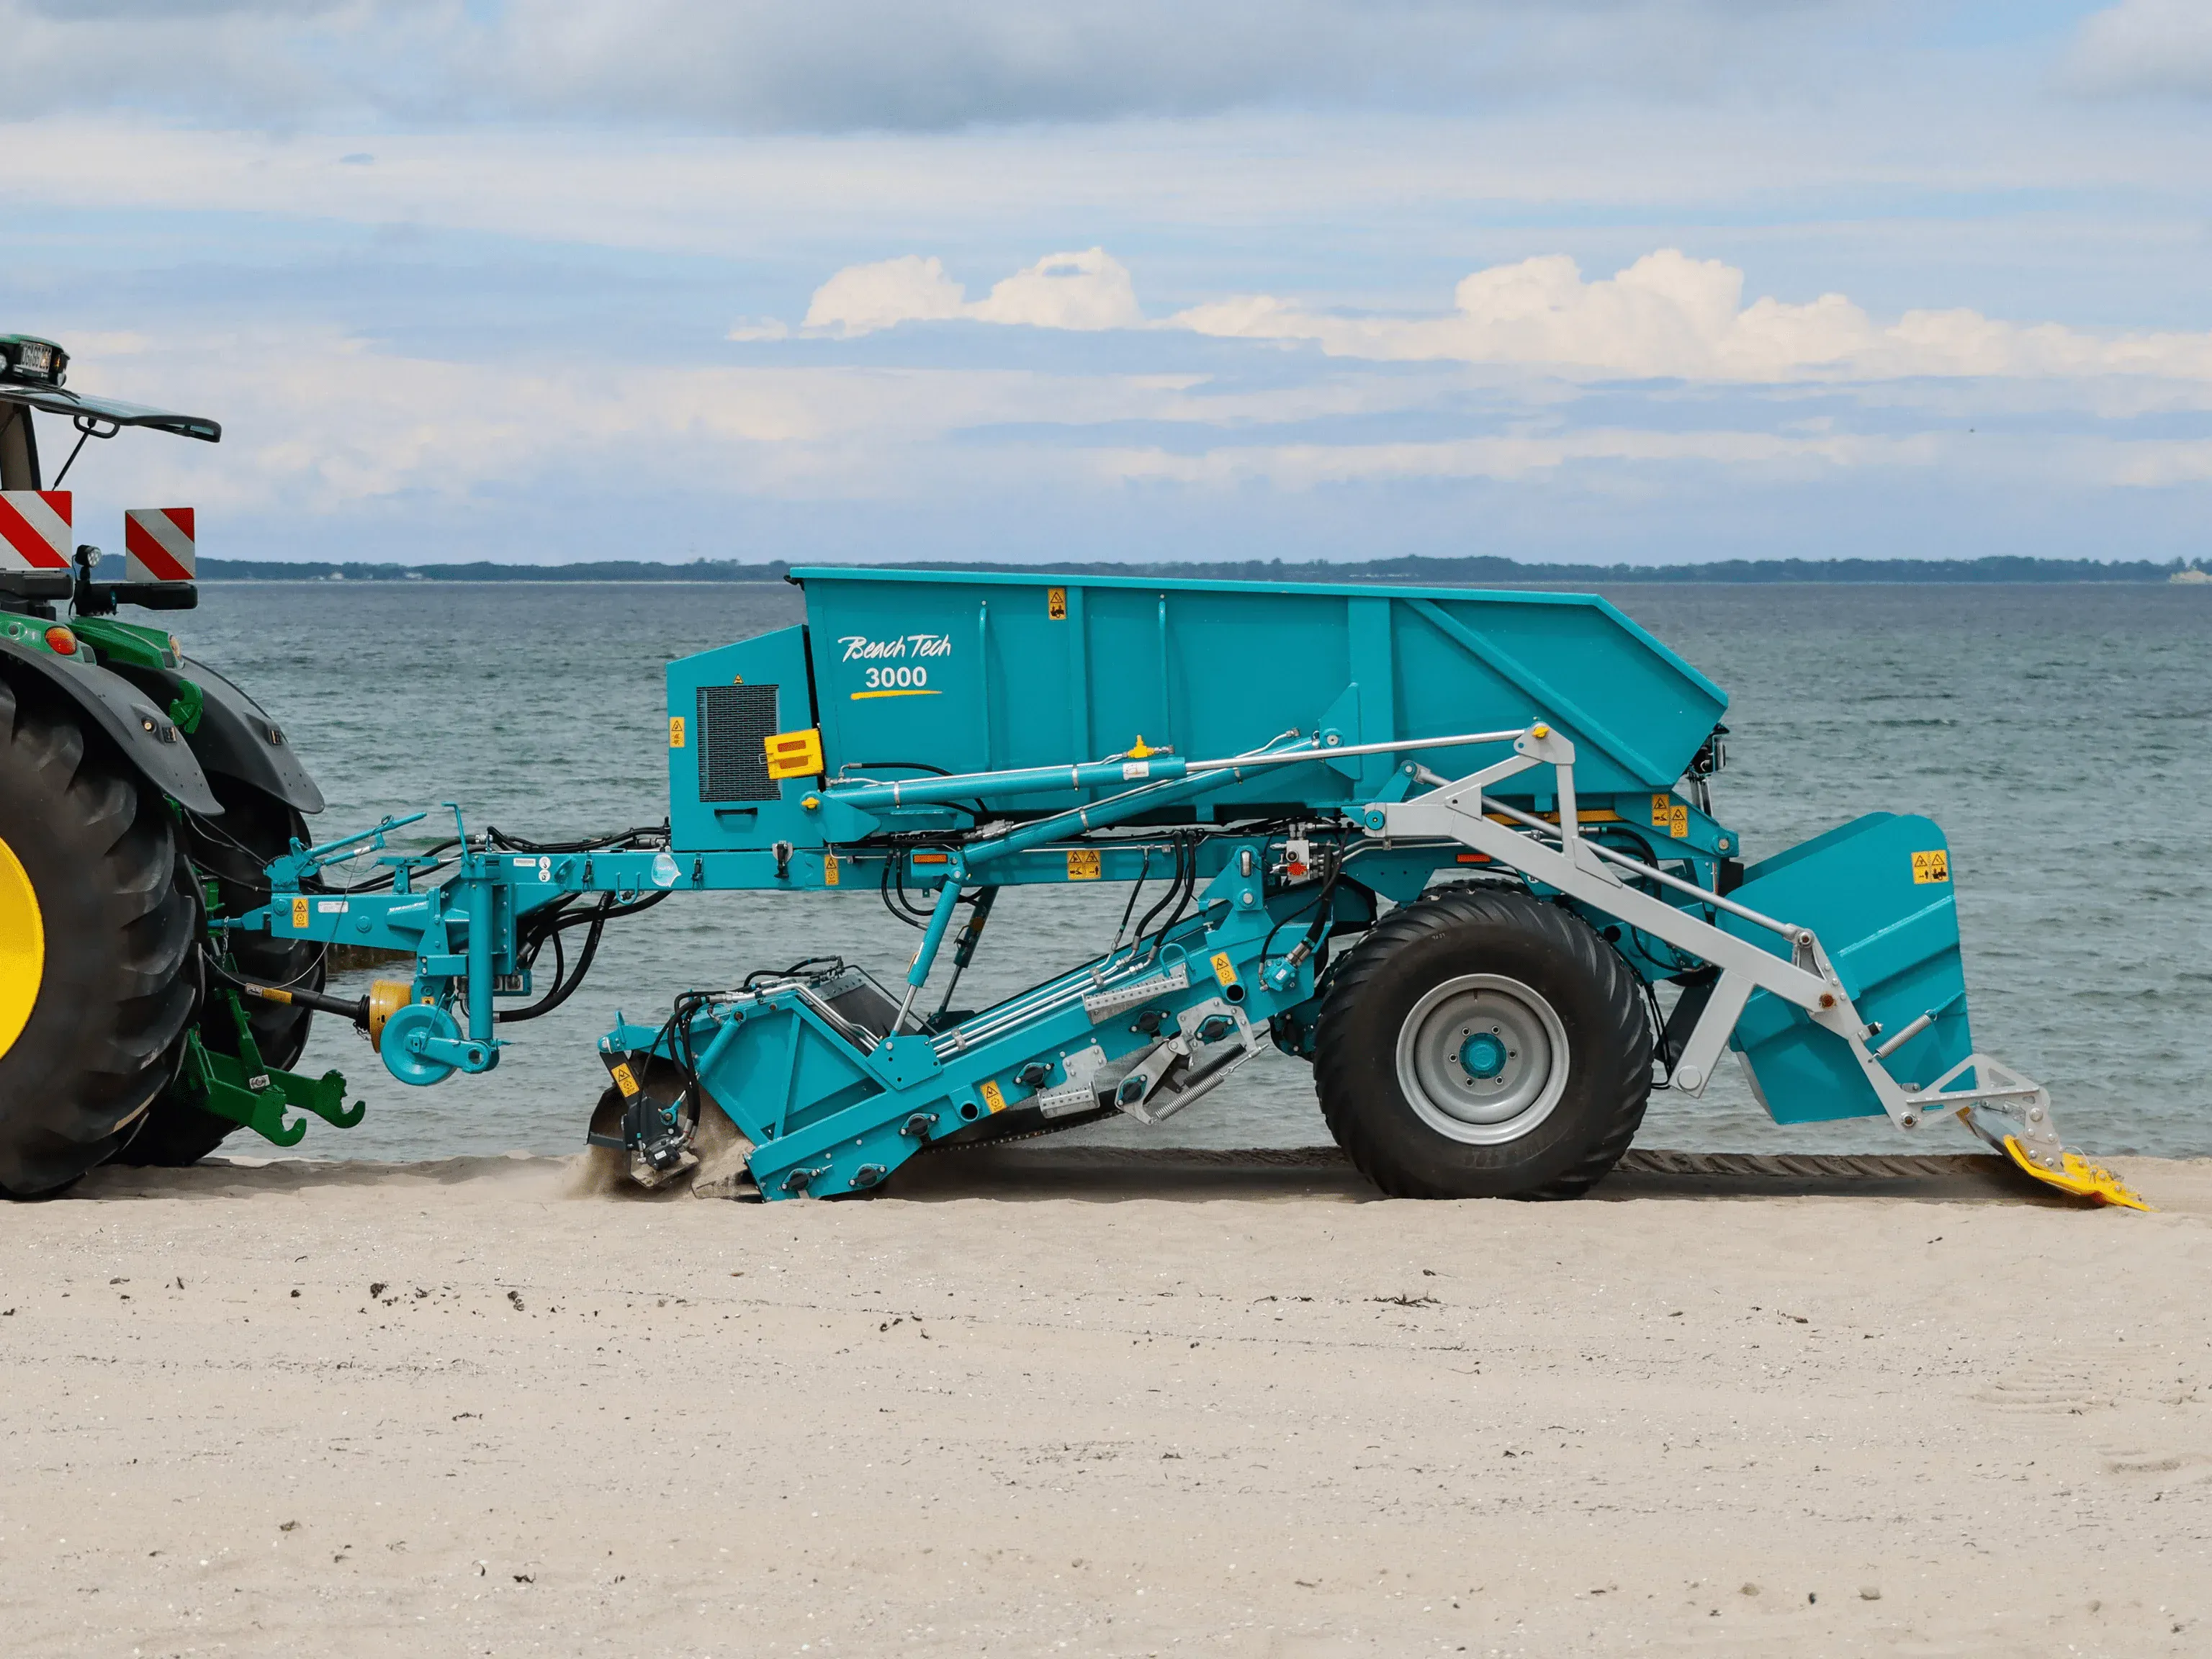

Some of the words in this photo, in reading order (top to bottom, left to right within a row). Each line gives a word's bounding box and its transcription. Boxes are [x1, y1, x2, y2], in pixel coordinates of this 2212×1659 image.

[837, 635, 906, 663] Beach
[907, 634, 951, 658] Tech
[866, 666, 927, 688] 3000
